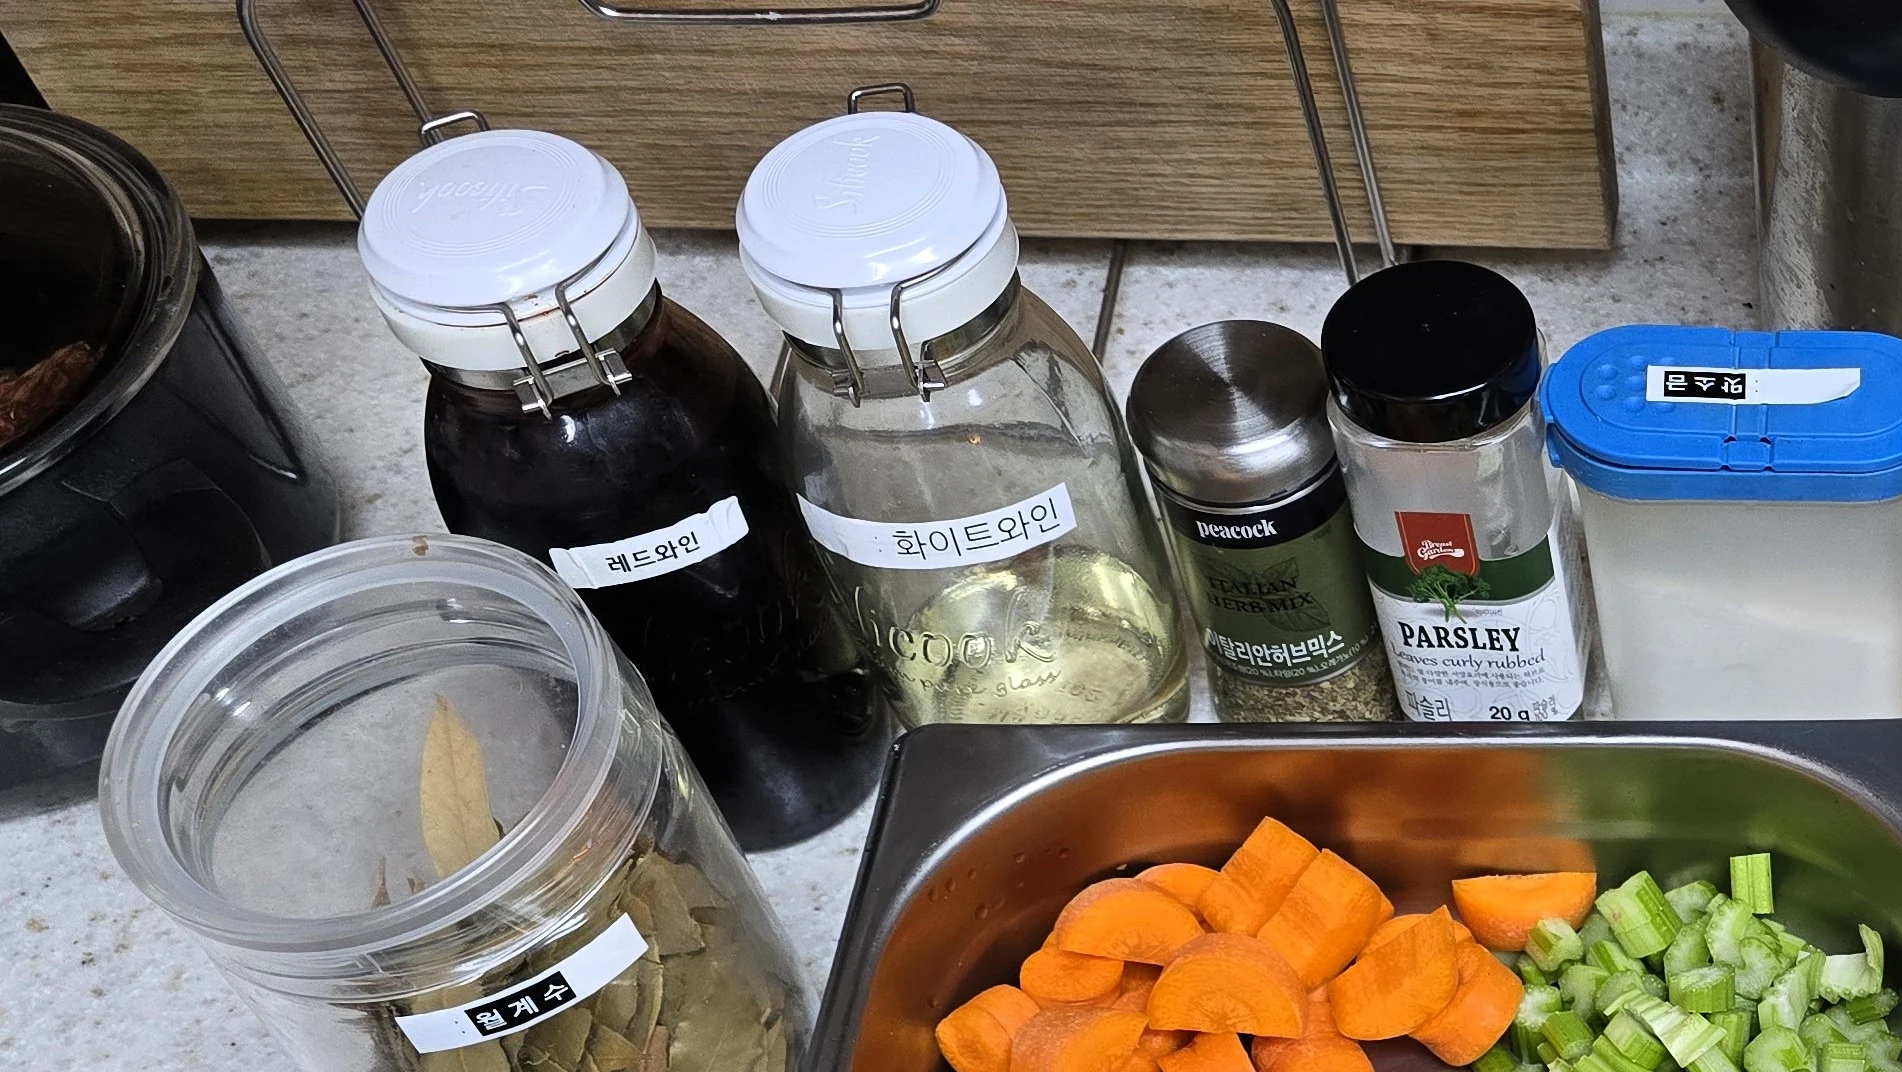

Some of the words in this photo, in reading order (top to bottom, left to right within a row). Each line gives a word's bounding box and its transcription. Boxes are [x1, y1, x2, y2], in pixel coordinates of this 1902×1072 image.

[1665, 373, 1743, 394] 맛소금
[891, 497, 1062, 561] 화이트와인
[1195, 519, 1278, 539] peacock
[605, 531, 701, 574] 레드와인
[1208, 575, 1299, 595] ITALIAN
[1204, 628, 1345, 667] 이탈리안허브믹스
[1397, 620, 1520, 652] PARSLEY
[1390, 640, 1439, 667] Leaves
[1442, 653, 1484, 673] curly
[1486, 647, 1546, 670] rubbed
[1489, 706, 1512, 721] 20
[475, 983, 570, 1031] 월계수
